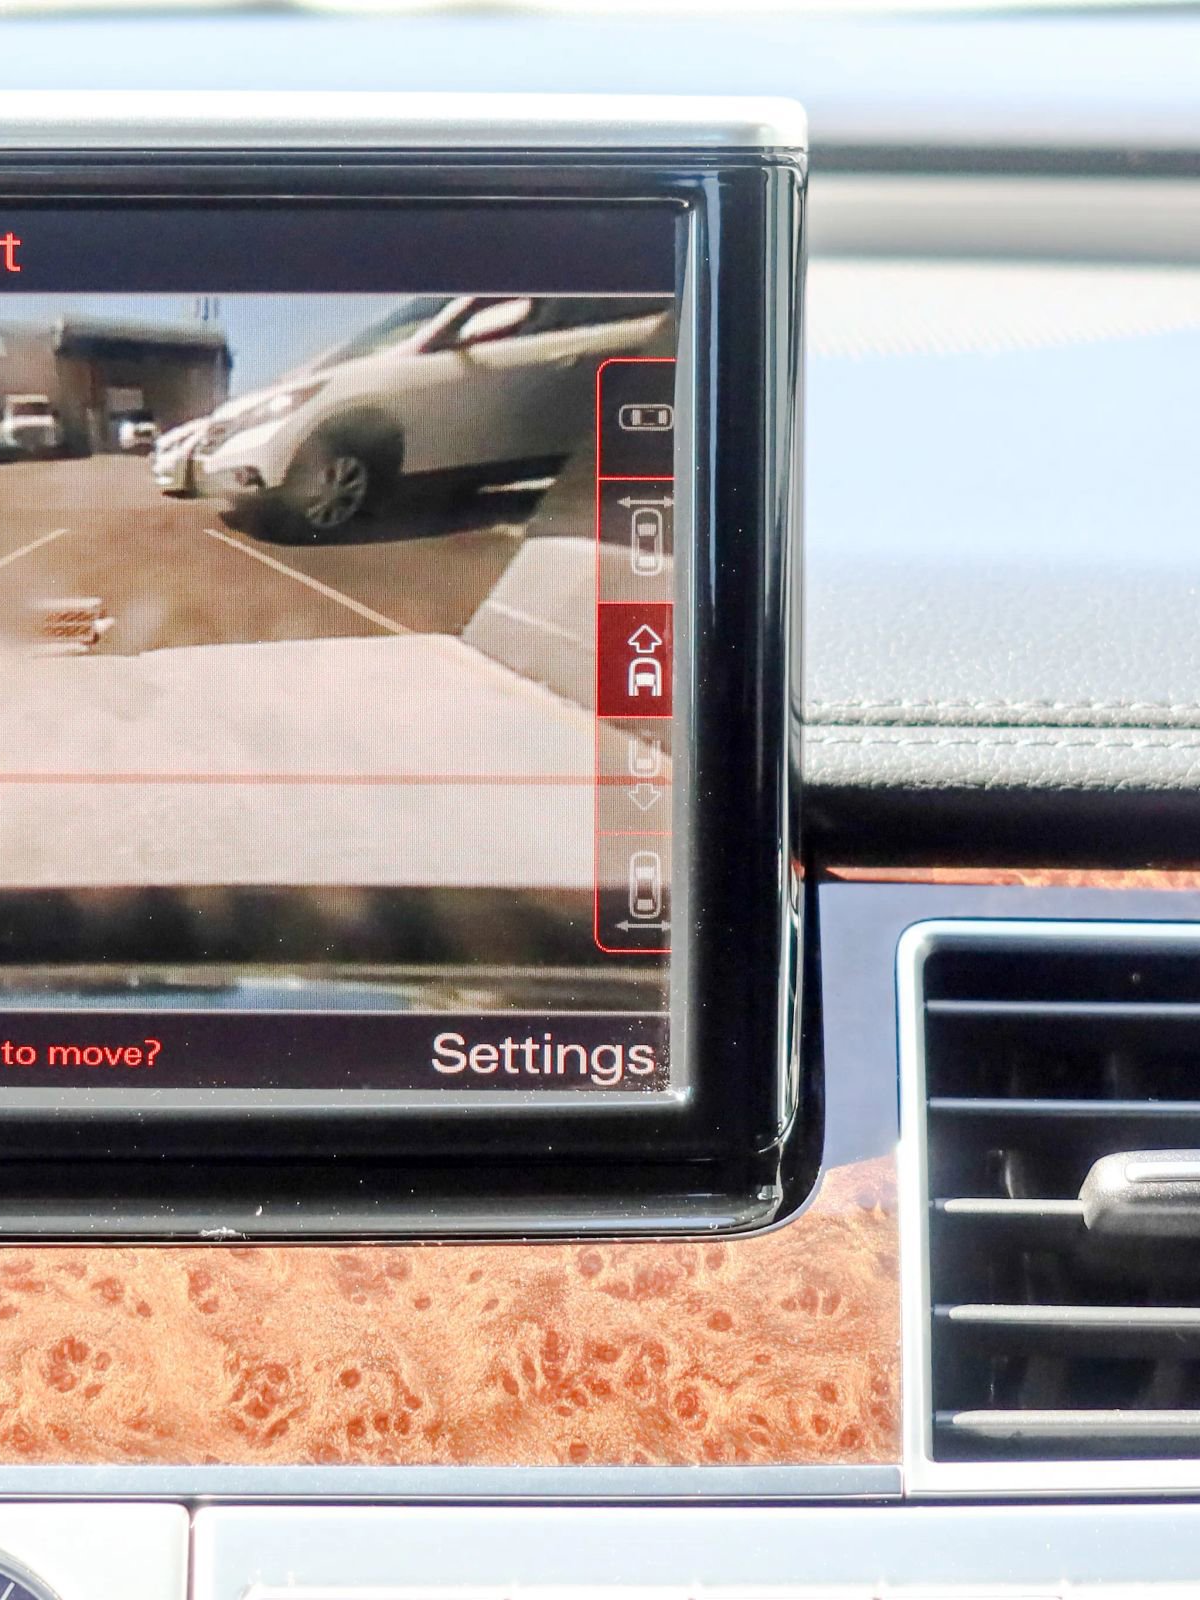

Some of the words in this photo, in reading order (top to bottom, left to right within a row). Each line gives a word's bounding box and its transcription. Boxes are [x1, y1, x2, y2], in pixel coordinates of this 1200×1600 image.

[1, 1040, 37, 1065] to
[47, 1039, 162, 1066] move?
[431, 1031, 655, 1086] Settings
